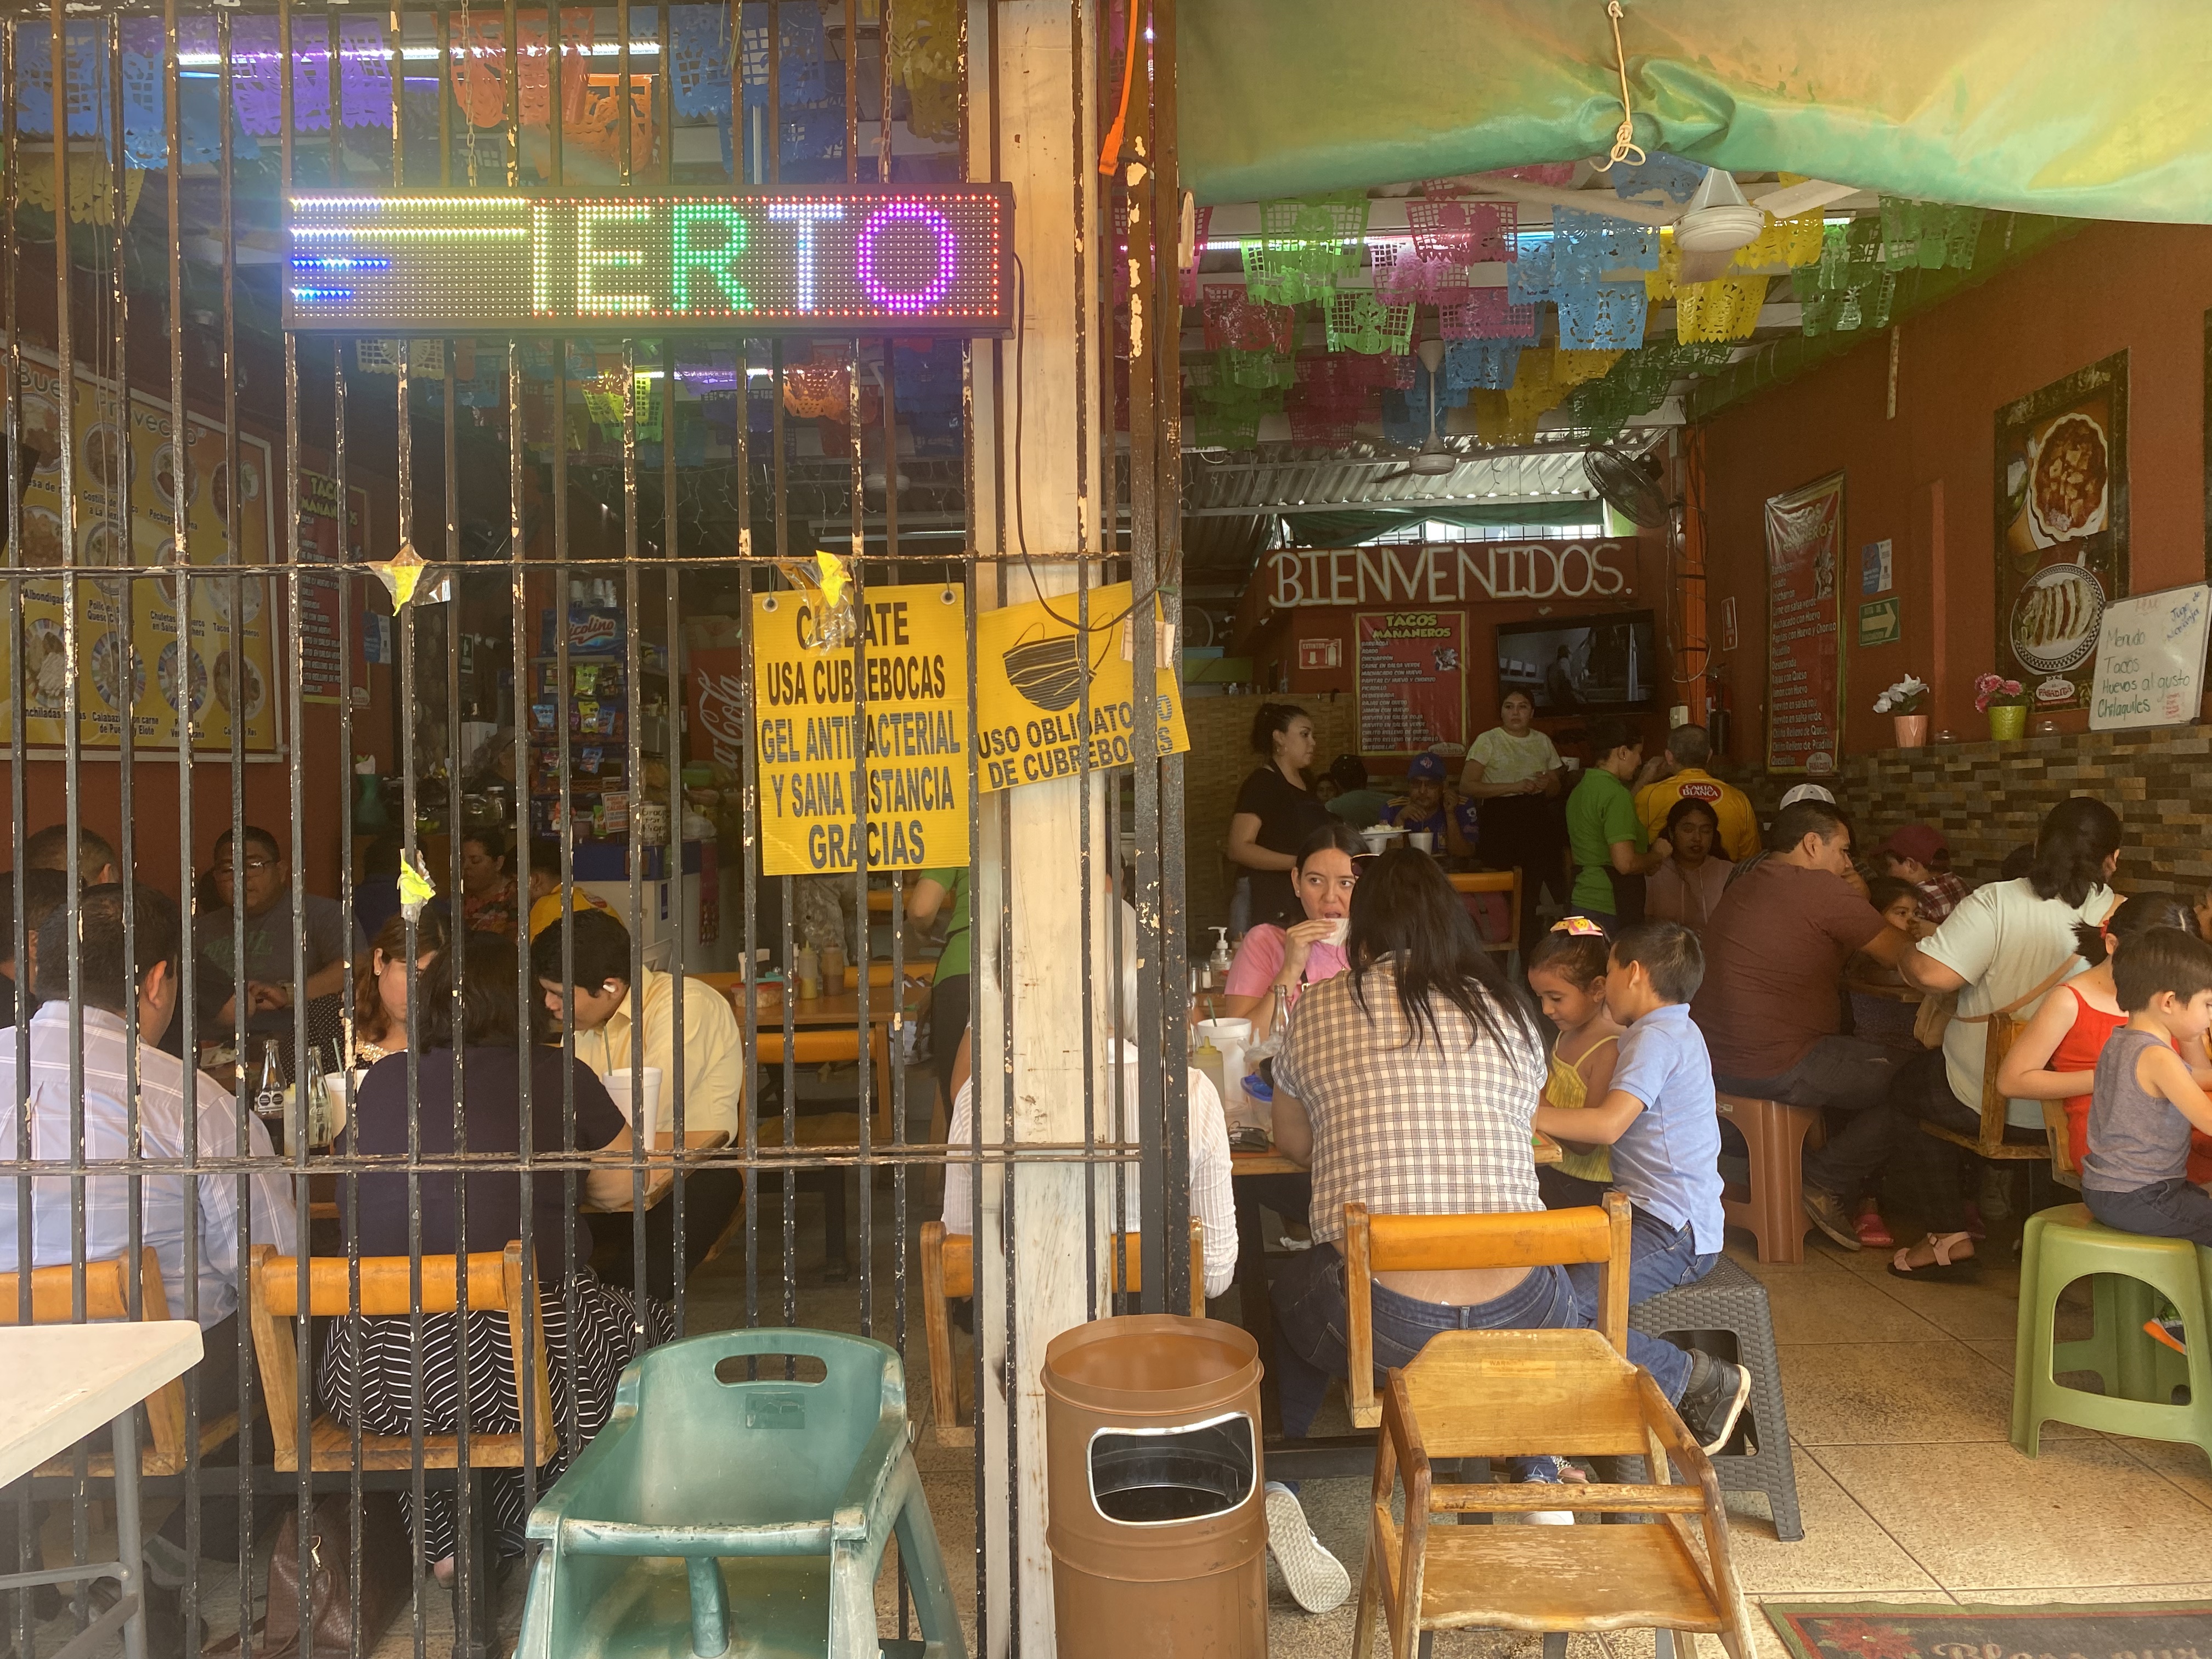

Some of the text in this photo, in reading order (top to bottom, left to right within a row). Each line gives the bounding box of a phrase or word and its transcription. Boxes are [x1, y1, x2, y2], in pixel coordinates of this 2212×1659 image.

[1386, 613, 1437, 627] TACOS
[1373, 628, 1452, 639] MAÑANEROS
[2106, 628, 2146, 650] Menudo
[2104, 656, 2140, 674] Tacos
[767, 654, 946, 706] USA CUBEBOCAS
[2038, 684, 2073, 697] PASADITA
[2102, 669, 2190, 702] Huevos al gusto
[25, 707, 61, 719] nchiladas
[2097, 694, 2151, 721] Chilaquiles
[99, 724, 108, 733] de
[139, 725, 155, 736] Elote
[142, 717, 159, 725] carne
[761, 710, 961, 764] GEL ANTIACTERIAL
[978, 725, 1020, 759] USO
[988, 758, 1019, 789] DE
[771, 774, 785, 818] Y
[791, 771, 846, 818] SANA
[1682, 789, 1718, 797] BLANCA
[808, 819, 925, 869] GRACIAS
